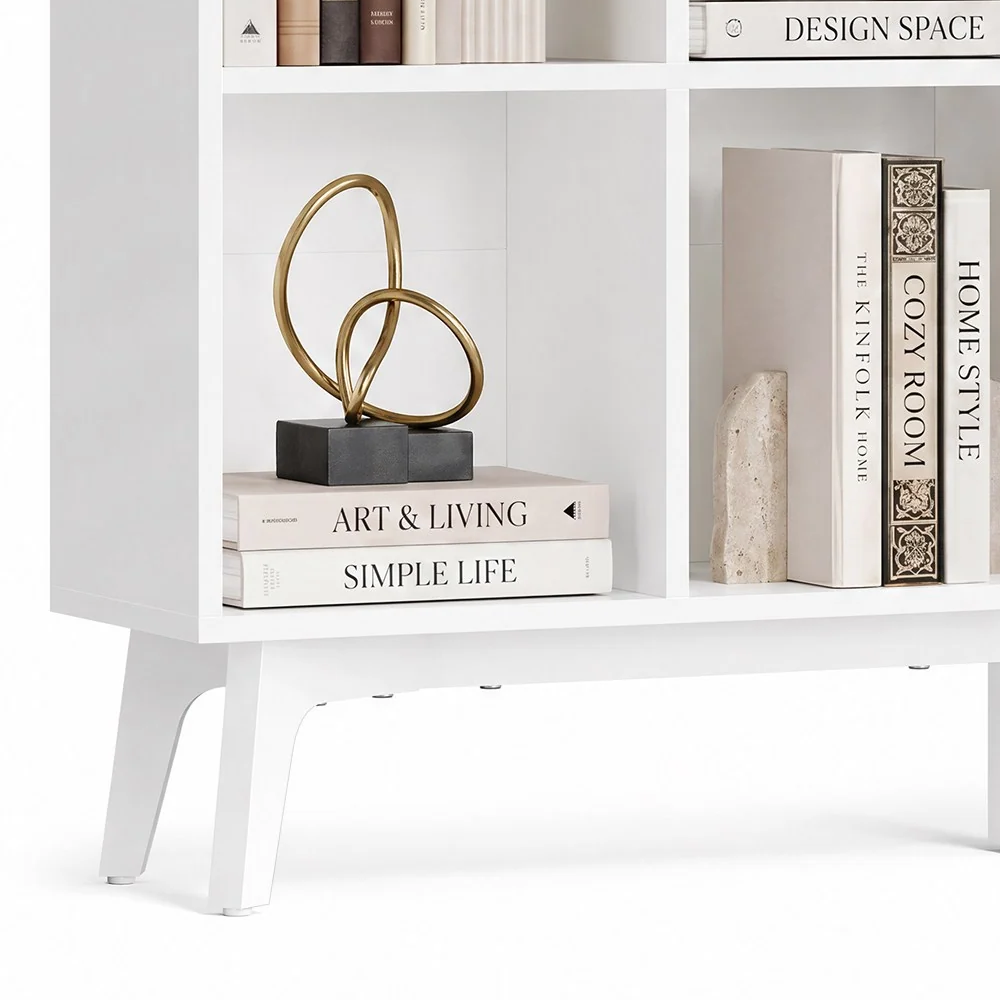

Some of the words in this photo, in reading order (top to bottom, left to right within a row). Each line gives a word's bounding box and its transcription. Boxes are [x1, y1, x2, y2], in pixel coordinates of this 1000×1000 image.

[785, 16, 889, 42] DESIGN
[898, 15, 985, 41] SPACE
[856, 252, 867, 288] THE
[903, 274, 926, 361] COZY
[958, 261, 981, 355] HOME
[855, 301, 870, 420] KINFOLK
[903, 371, 926, 467] ROOM
[958, 364, 981, 461] STYLE
[857, 432, 868, 482] HOME
[332, 505, 391, 533] ART
[398, 504, 421, 531] &
[429, 500, 527, 530] LIVING
[344, 561, 449, 590] SIMPLE
[458, 558, 517, 585] LIFE
